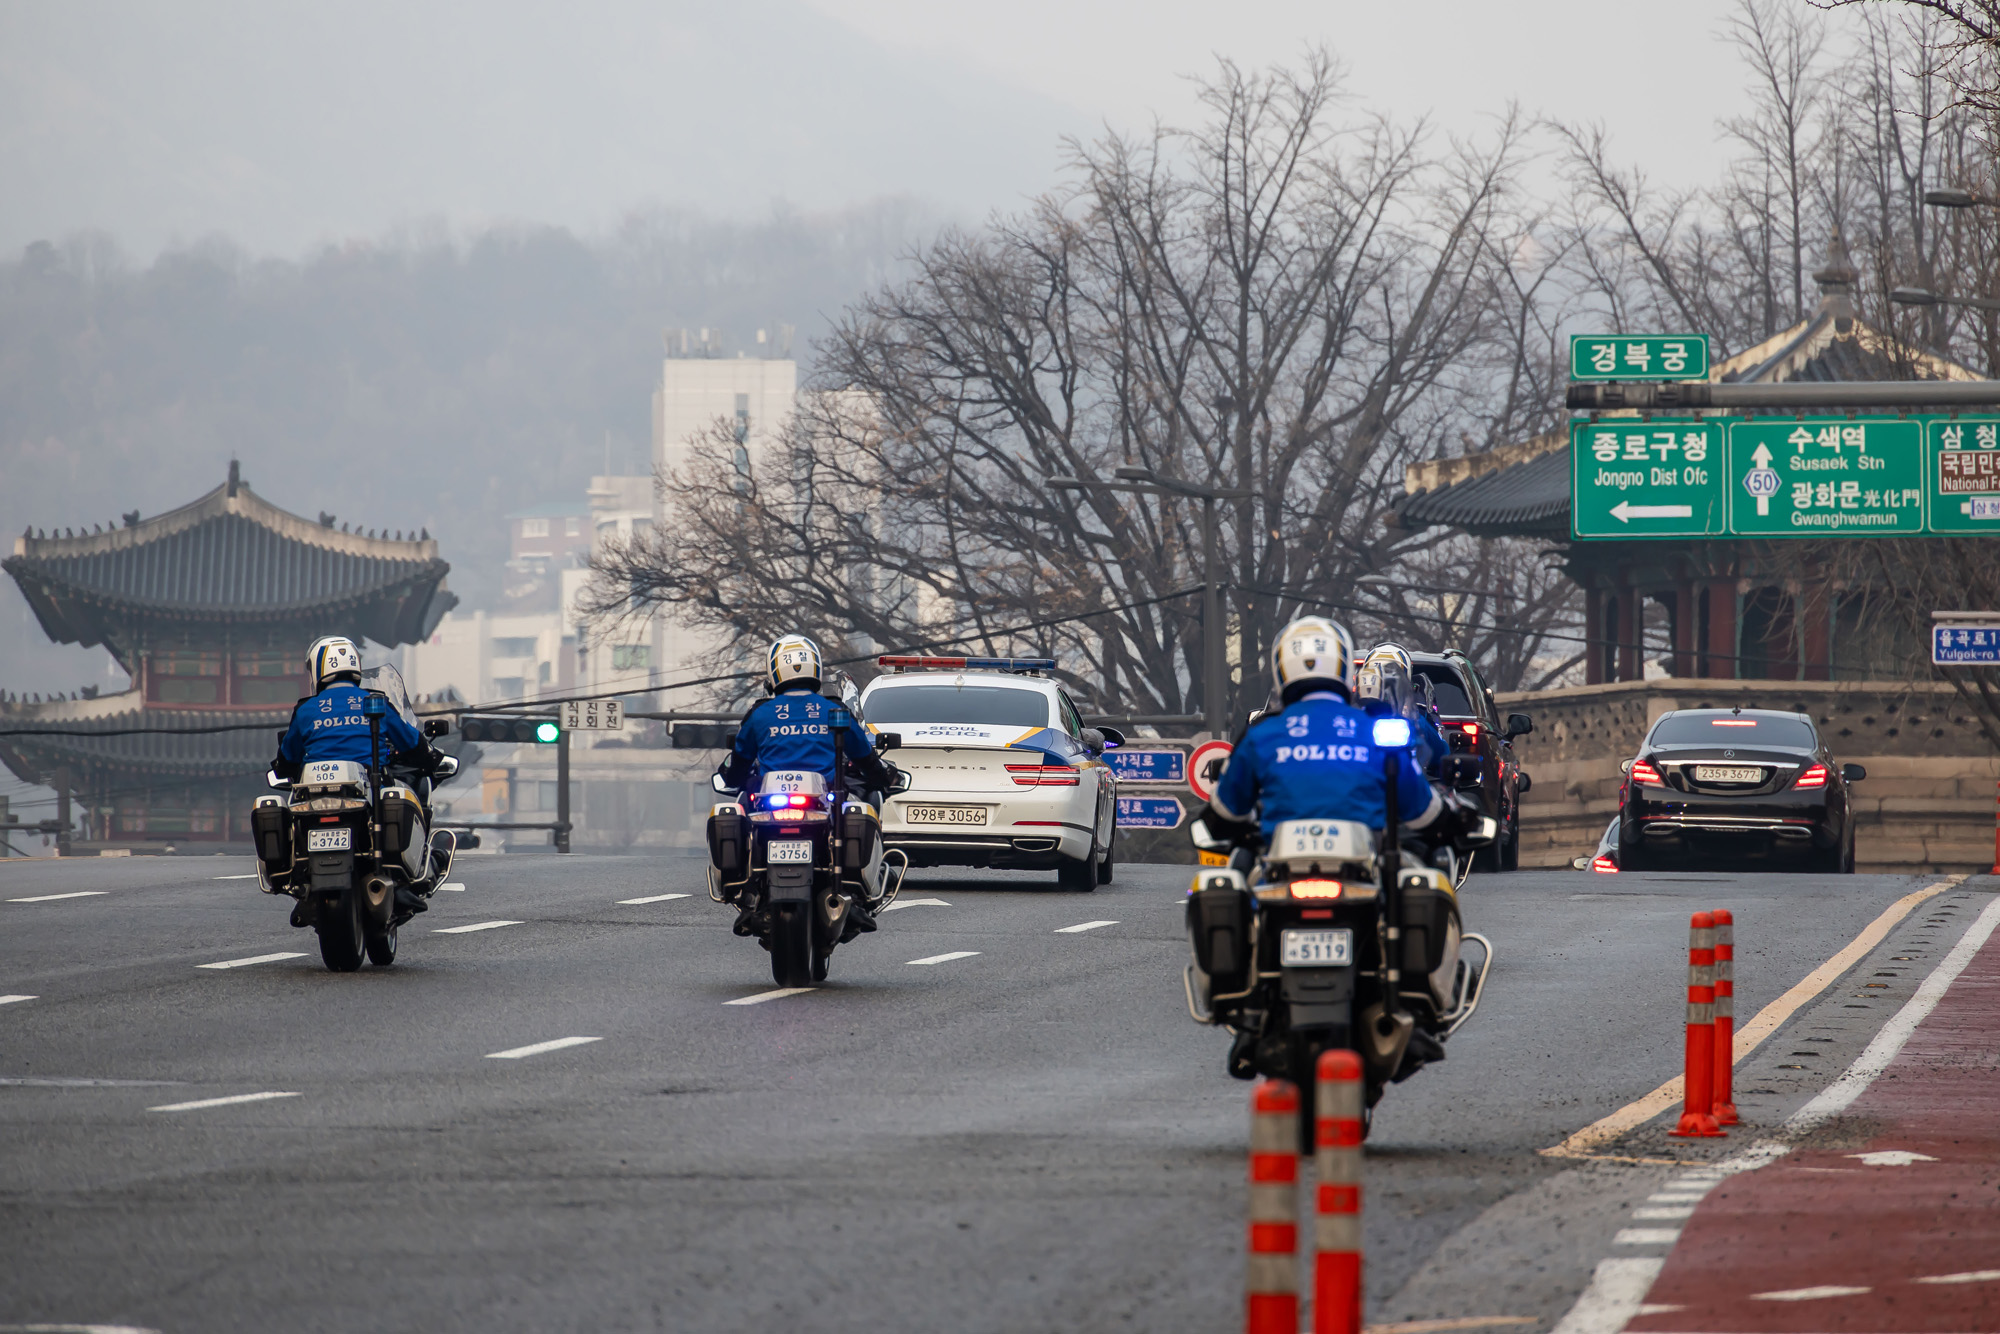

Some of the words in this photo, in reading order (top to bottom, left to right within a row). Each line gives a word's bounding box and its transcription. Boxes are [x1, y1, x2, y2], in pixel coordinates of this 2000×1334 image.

[1590, 343, 1688, 372] 경복궁
[1591, 432, 1708, 462] 종로구청
[1787, 425, 1866, 454] 수색역
[1790, 455, 1848, 470] Susaek
[1857, 455, 1885, 470] Stn
[1943, 453, 2000, 475] 국립민
[1594, 468, 1644, 490] Jongno
[1651, 467, 1678, 486] Dist
[1684, 466, 1708, 485] Ofc
[1752, 473, 1773, 491] 50
[1943, 475, 1989, 491] National
[1991, 475, 2000, 490] F
[1790, 481, 1861, 509] 광화문
[1790, 511, 1898, 528] Gwanghwamun
[1939, 630, 2000, 648] 율곡로1
[328, 655, 357, 668] 경찰
[782, 651, 807, 664] 경찰
[1939, 649, 1994, 661] Yulgok-ro
[318, 696, 363, 713] 경찰
[775, 703, 822, 719] 경찰
[313, 715, 370, 730] POLICE
[769, 724, 829, 737] POLICE
[1114, 754, 1155, 768] 사직로
[1276, 744, 1369, 764] POLICE
[316, 772, 335, 781] 505
[1116, 768, 1153, 779] Sajik-ro
[1730, 769, 1756, 779] 3677
[781, 783, 799, 792] 512
[912, 808, 945, 821] 998루
[948, 810, 981, 822] 3056
[320, 837, 347, 847] 3742
[1297, 839, 1334, 851] 510
[780, 849, 808, 859] 3756
[1301, 944, 1345, 959] 5119
